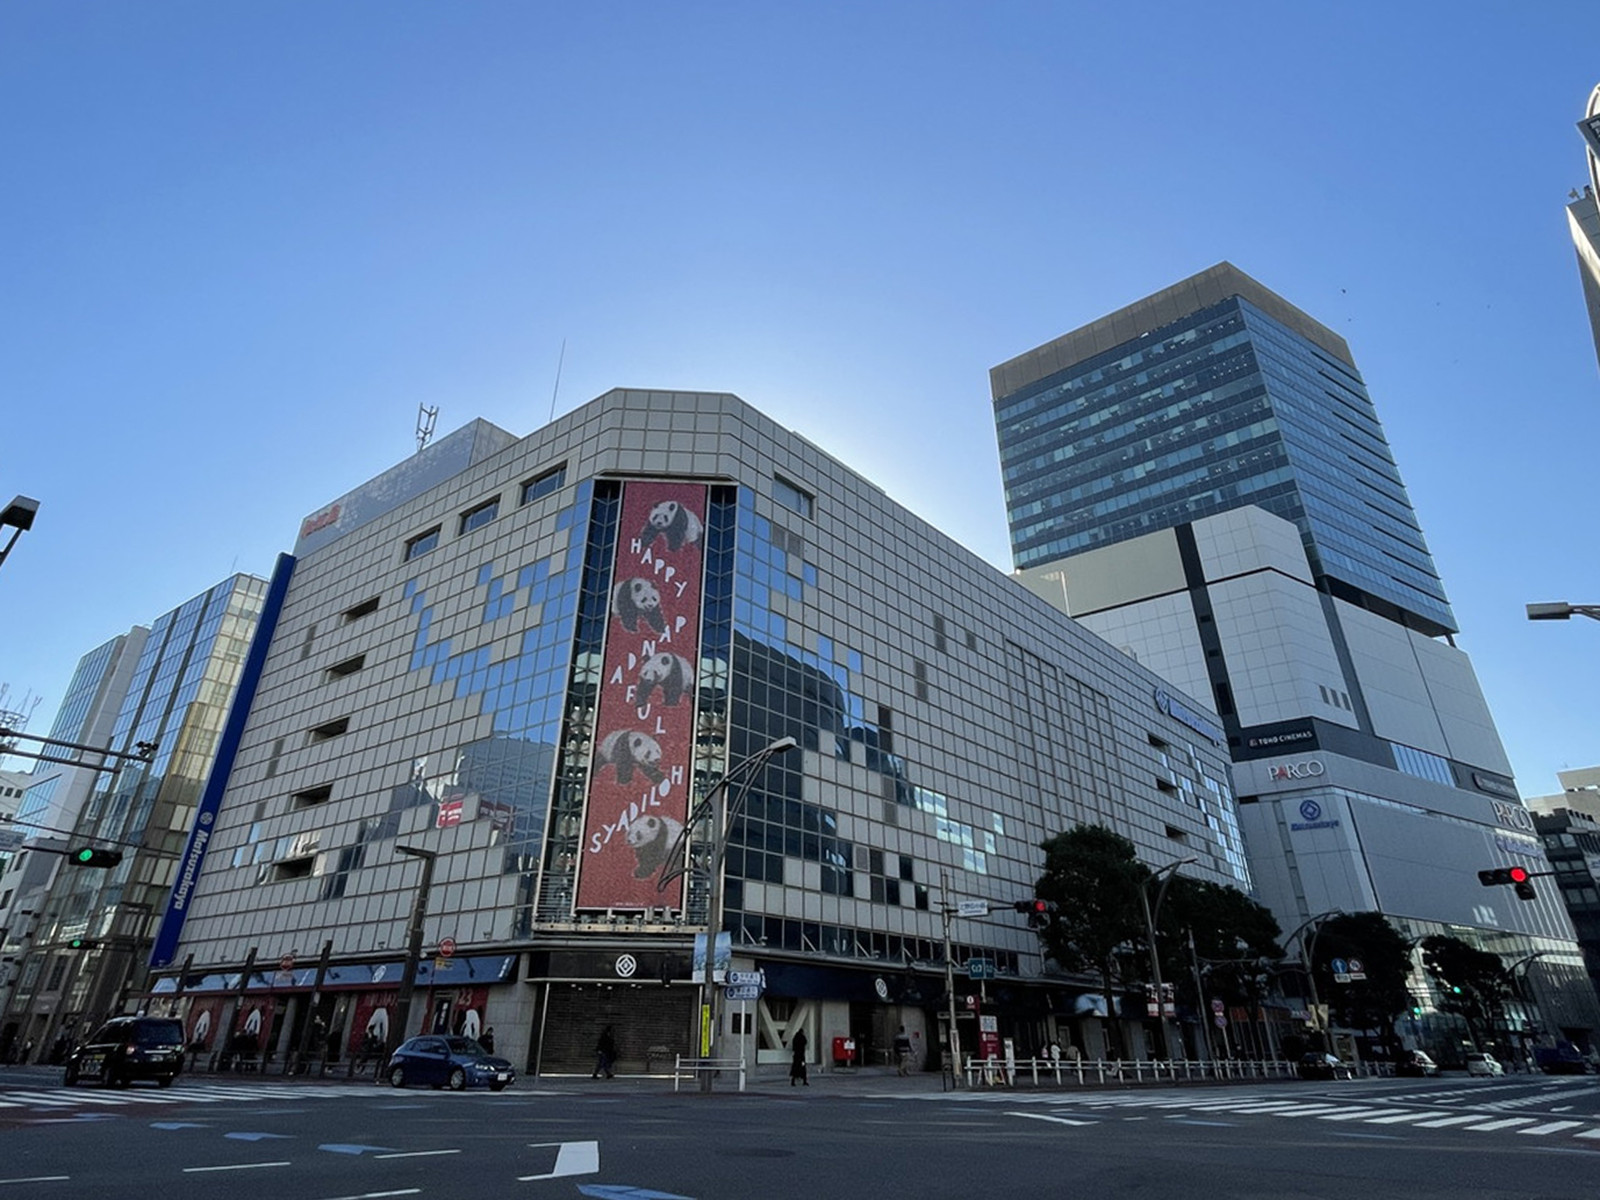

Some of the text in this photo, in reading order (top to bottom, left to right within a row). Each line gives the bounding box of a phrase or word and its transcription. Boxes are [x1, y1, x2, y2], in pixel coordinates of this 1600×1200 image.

[630, 538, 687, 598] HAPPY
[1279, 731, 1313, 742] CINEMAS
[1267, 760, 1324, 781] PARCO
[1491, 799, 1536, 832] PARCO
[173, 829, 209, 910] Matsuzakaya
